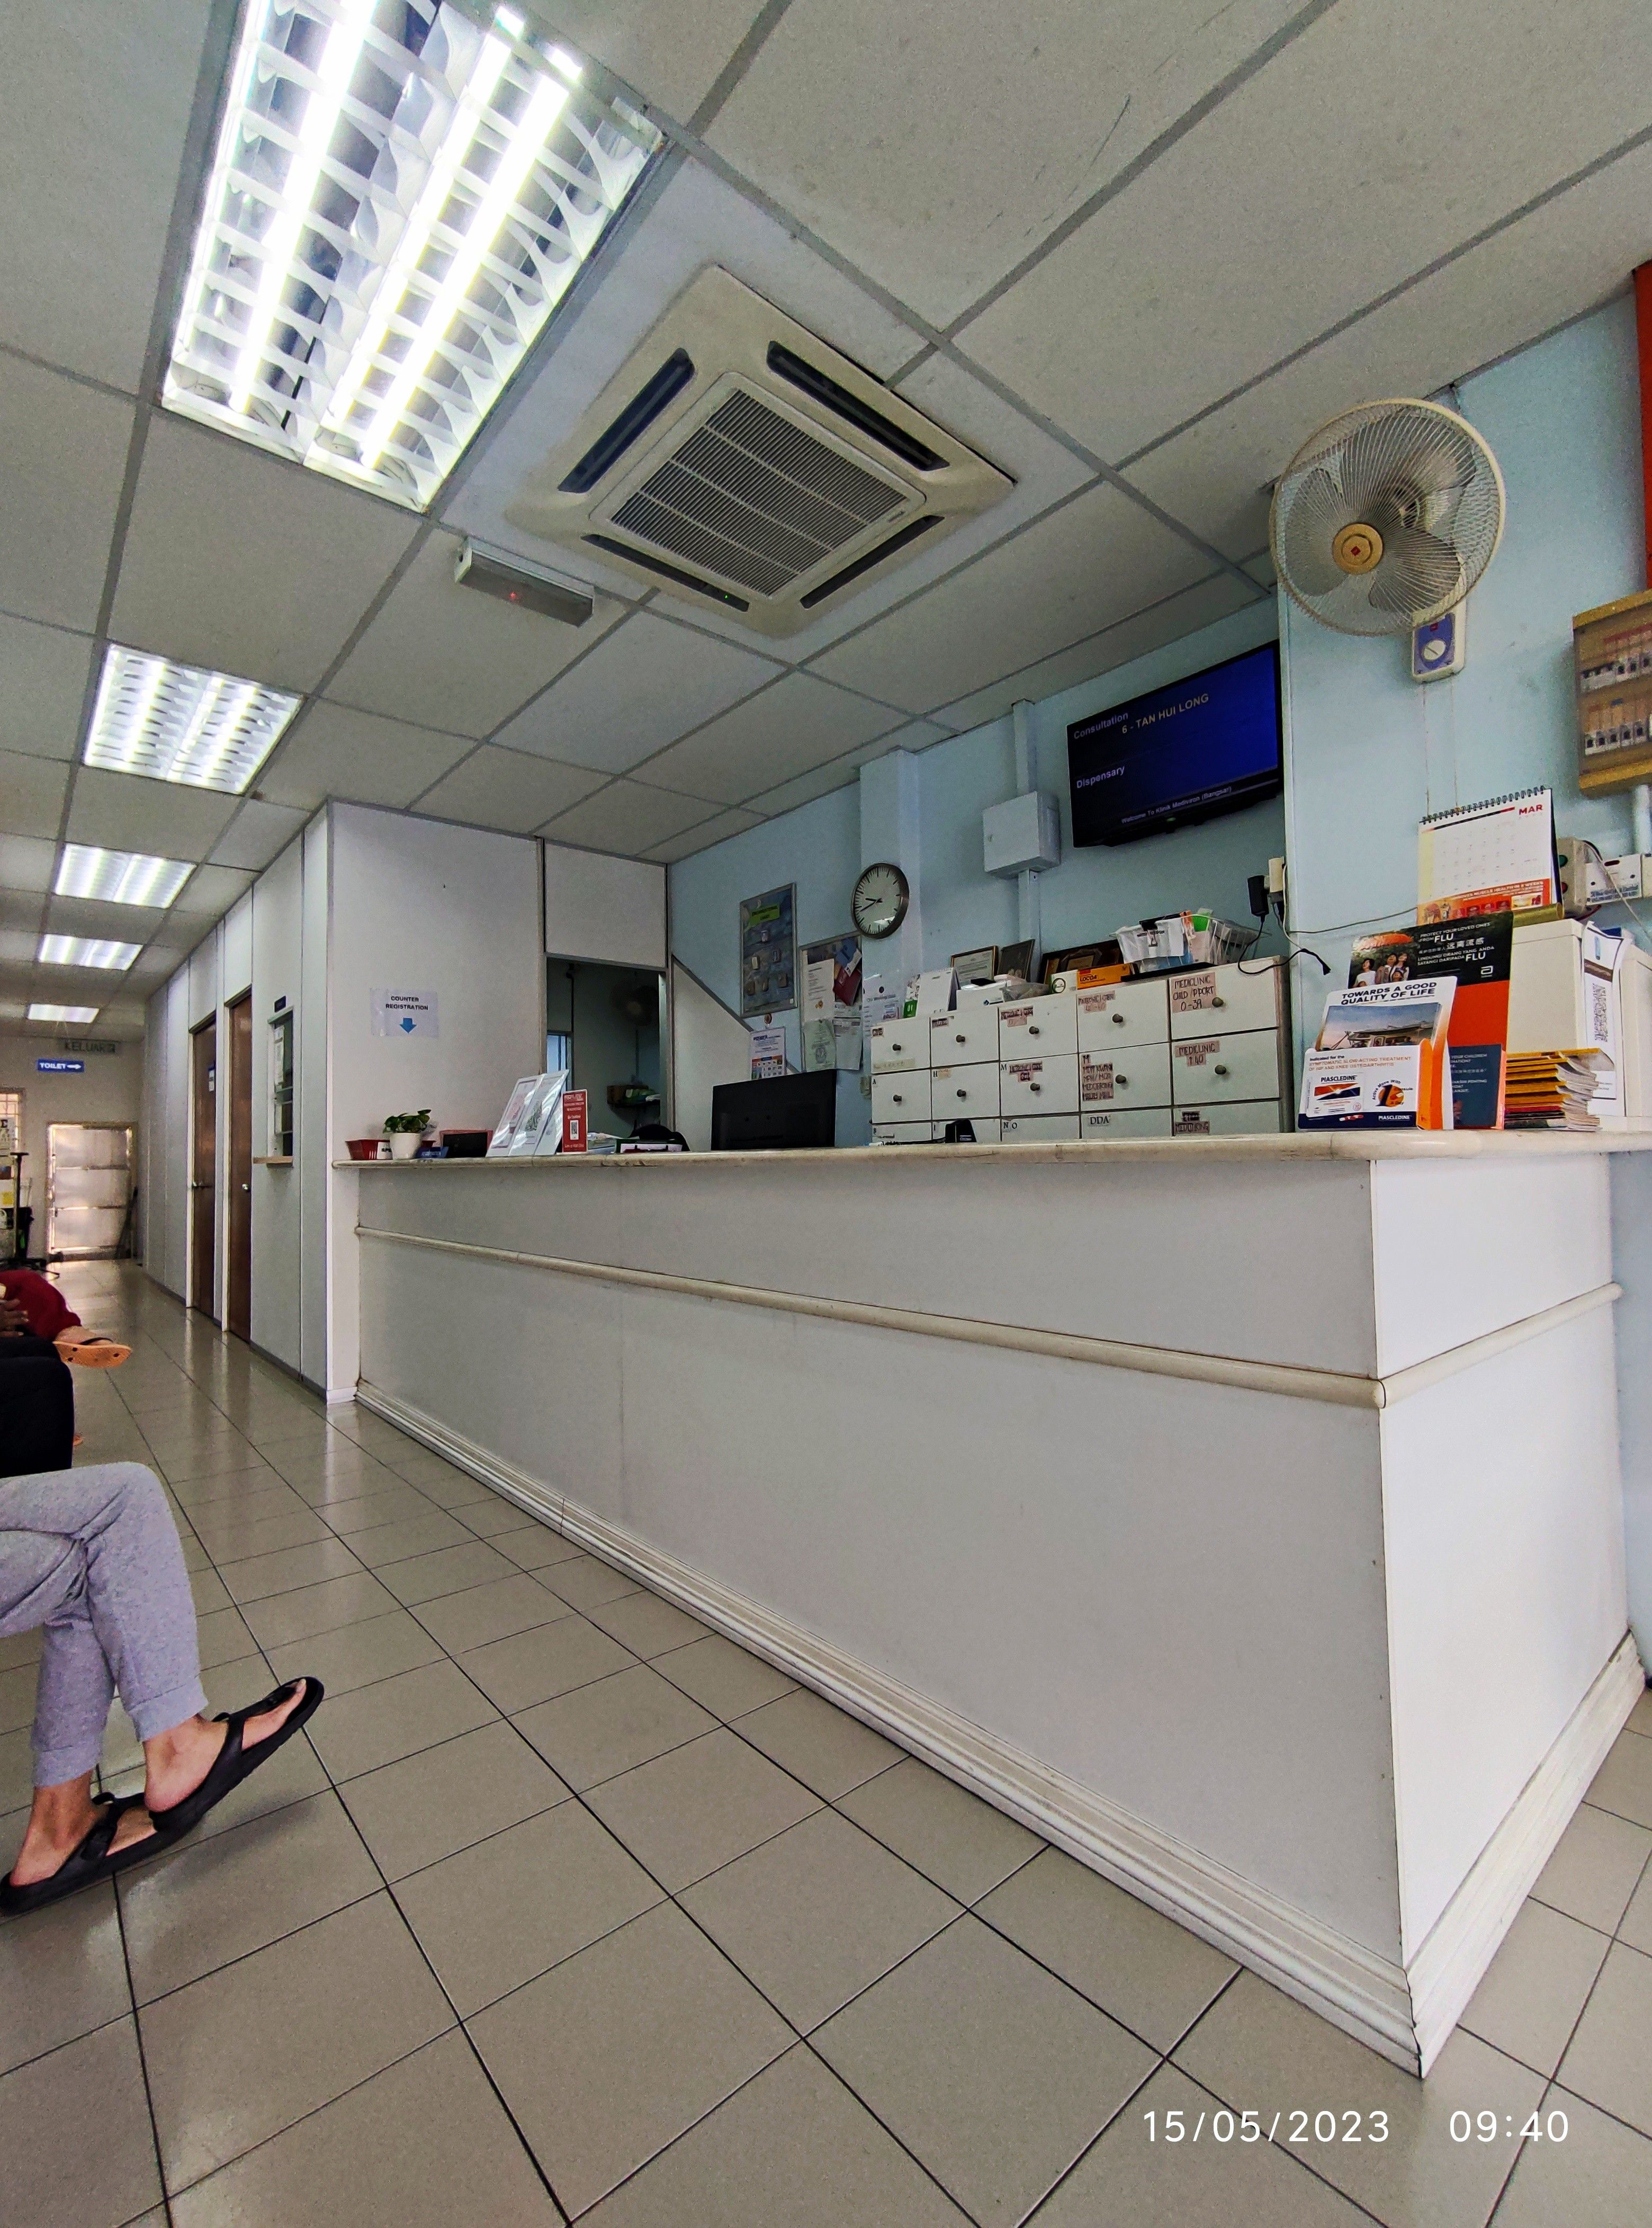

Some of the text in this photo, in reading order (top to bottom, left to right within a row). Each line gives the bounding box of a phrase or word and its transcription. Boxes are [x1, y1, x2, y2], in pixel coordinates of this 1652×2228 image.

[1122, 725, 1127, 734] 6
[1136, 714, 1155, 728] TAN
[1159, 706, 1175, 720] HUI
[1179, 693, 1209, 713] LONG
[1074, 713, 1128, 739] Consultation
[1077, 766, 1125, 788] Dispensary
[1156, 804, 1171, 813] Klinik
[1519, 804, 1543, 815] MAR
[1434, 933, 1453, 942] FLU
[1466, 951, 1486, 962] FLU
[1174, 975, 1211, 989] MEDICLINIC
[1342, 987, 1390, 999] TOWARDS
[1341, 994, 1387, 1005] QUALITY
[1179, 1043, 1215, 1056] MEDICLINIC
[1090, 1116, 1109, 1125] DDA
